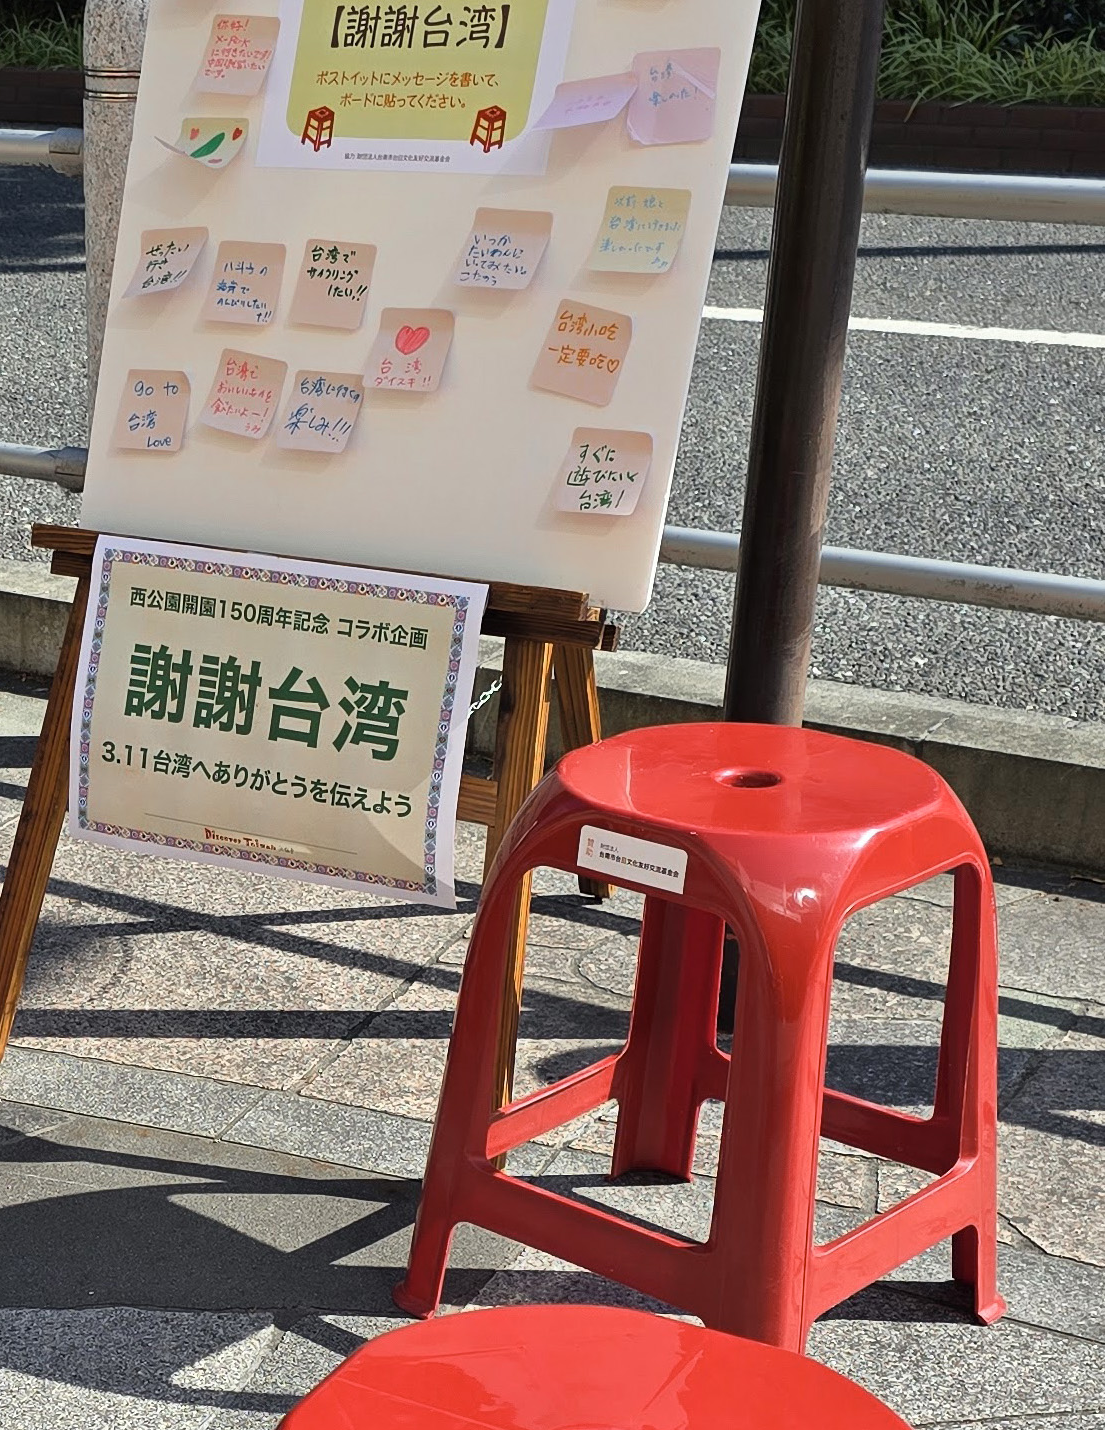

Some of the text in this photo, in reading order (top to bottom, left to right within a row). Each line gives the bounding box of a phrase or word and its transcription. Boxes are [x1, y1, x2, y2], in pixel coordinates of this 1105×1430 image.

[330, 4, 511, 48] 【謝謝台湾】
[316, 71, 500, 87] ポストイットにメッセージを書いて、
[339, 93, 466, 108] ボードに貼ってください。
[311, 245, 356, 264] 台湾で
[307, 267, 359, 283] サイクリング
[134, 381, 179, 396] go to
[130, 587, 429, 650] 西公園開園150周年記念 コラボ企画
[124, 643, 410, 762] 謝謝台湾
[101, 740, 413, 818] 3.11台湾へありがとうを伝えよう
